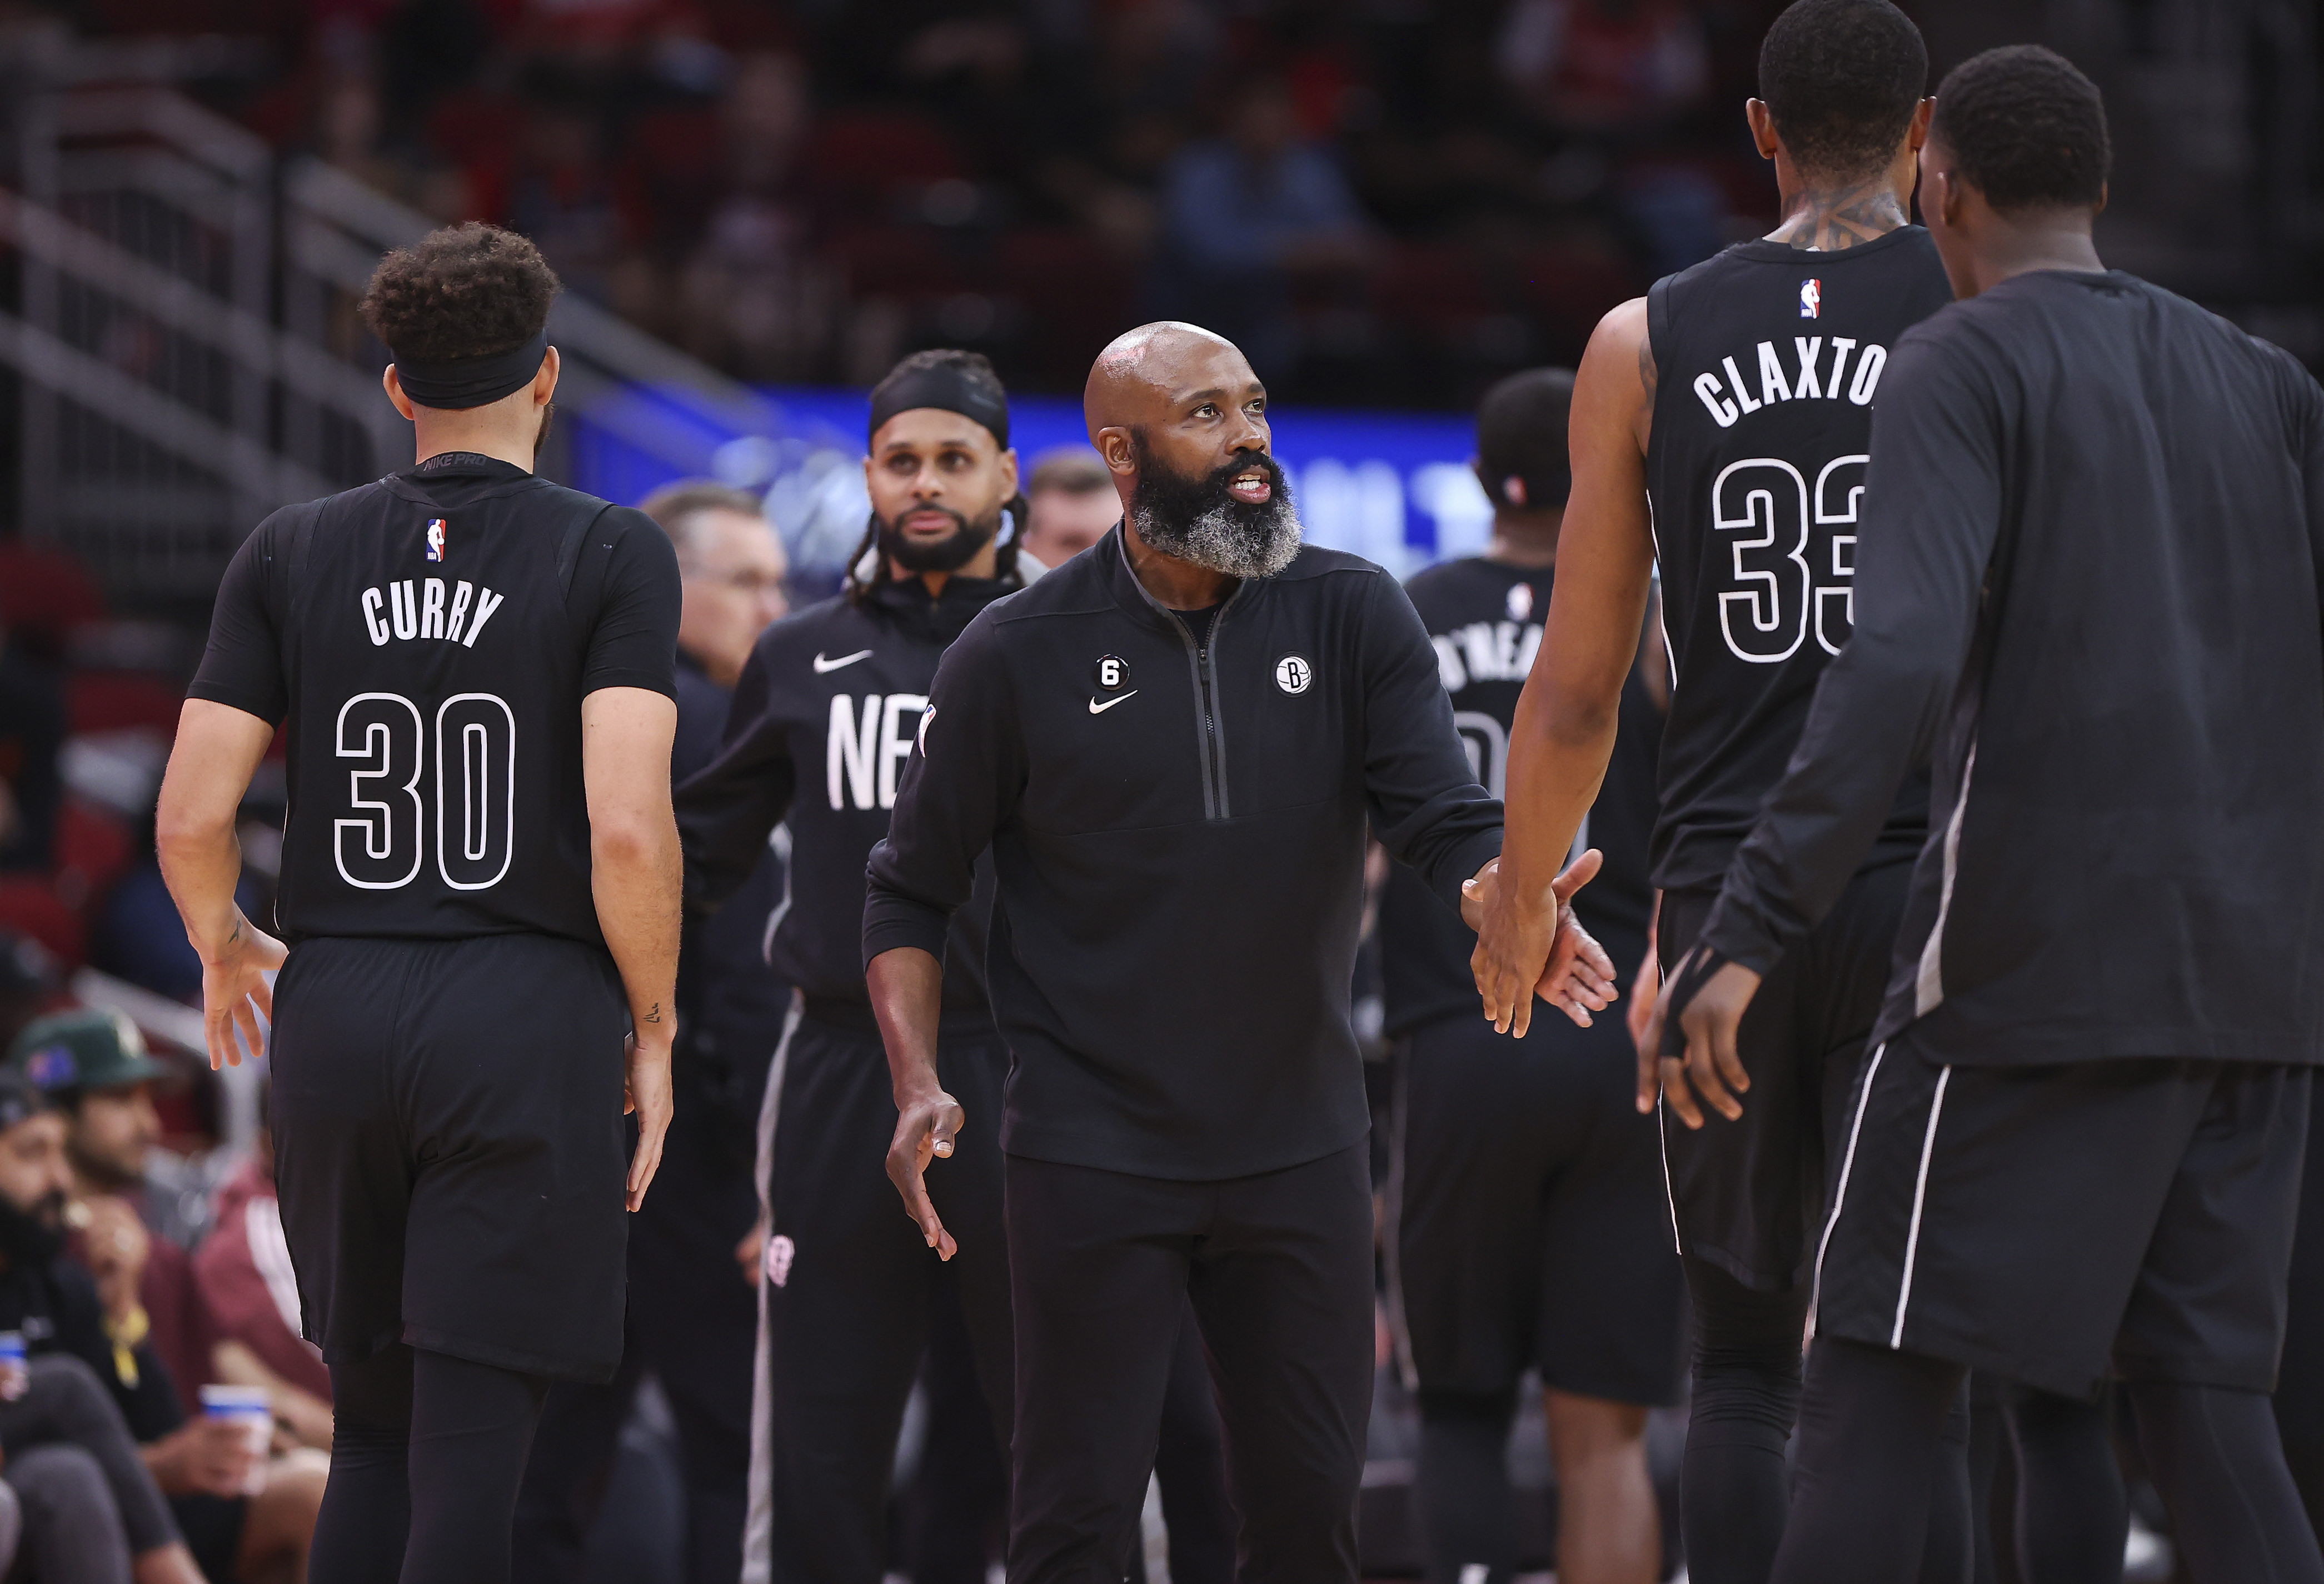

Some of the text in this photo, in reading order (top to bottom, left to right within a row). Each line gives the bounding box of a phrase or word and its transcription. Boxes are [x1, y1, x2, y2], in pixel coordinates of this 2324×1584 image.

[1694, 337, 1887, 428] CLAXTO
[423, 453, 487, 471] NIKE PRO
[427, 552, 437, 560] NBA
[361, 578, 505, 648] CURRY
[1101, 659, 1120, 685] 6
[1287, 662, 1301, 689] B
[334, 692, 516, 890] 30
